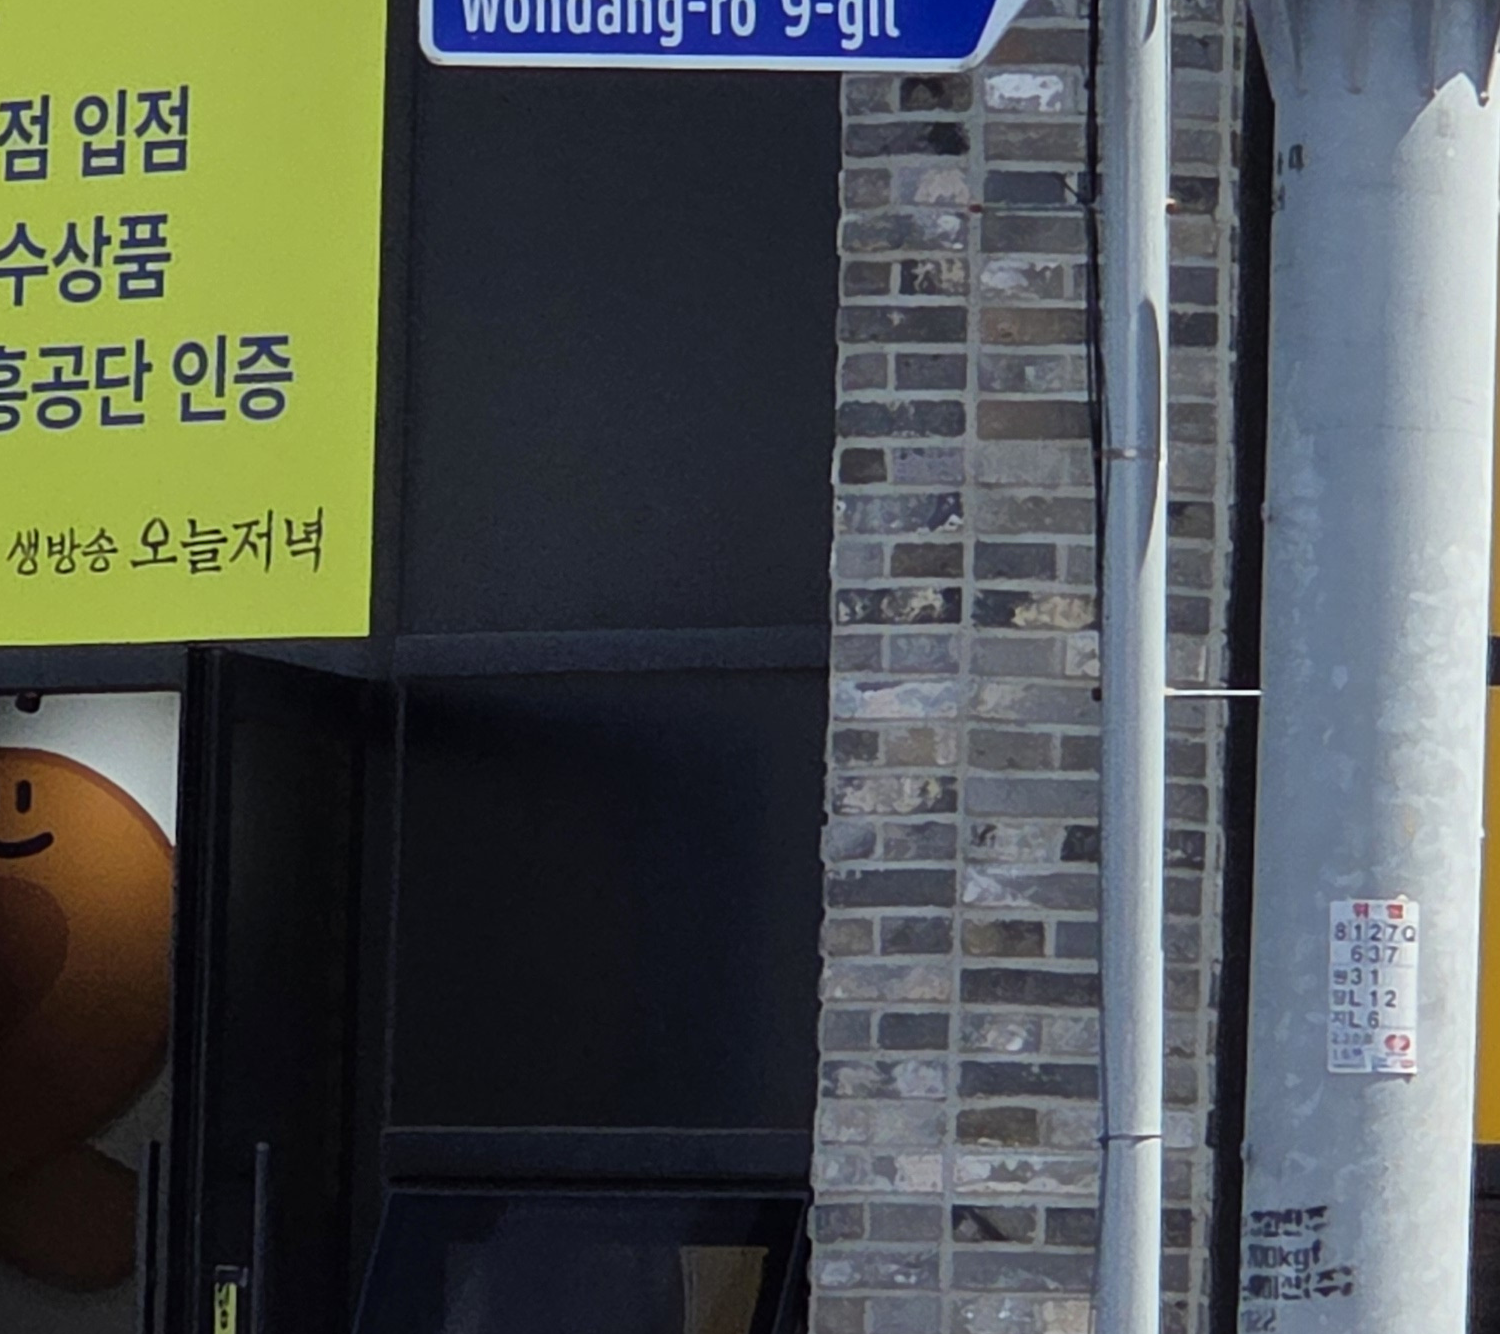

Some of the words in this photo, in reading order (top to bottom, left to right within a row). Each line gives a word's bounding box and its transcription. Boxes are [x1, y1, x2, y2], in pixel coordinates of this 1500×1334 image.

[73, 84, 192, 177] 입점
[172, 333, 294, 424] 인증
[6, 527, 119, 577] 생방송
[130, 506, 325, 575] 오늘저녁
